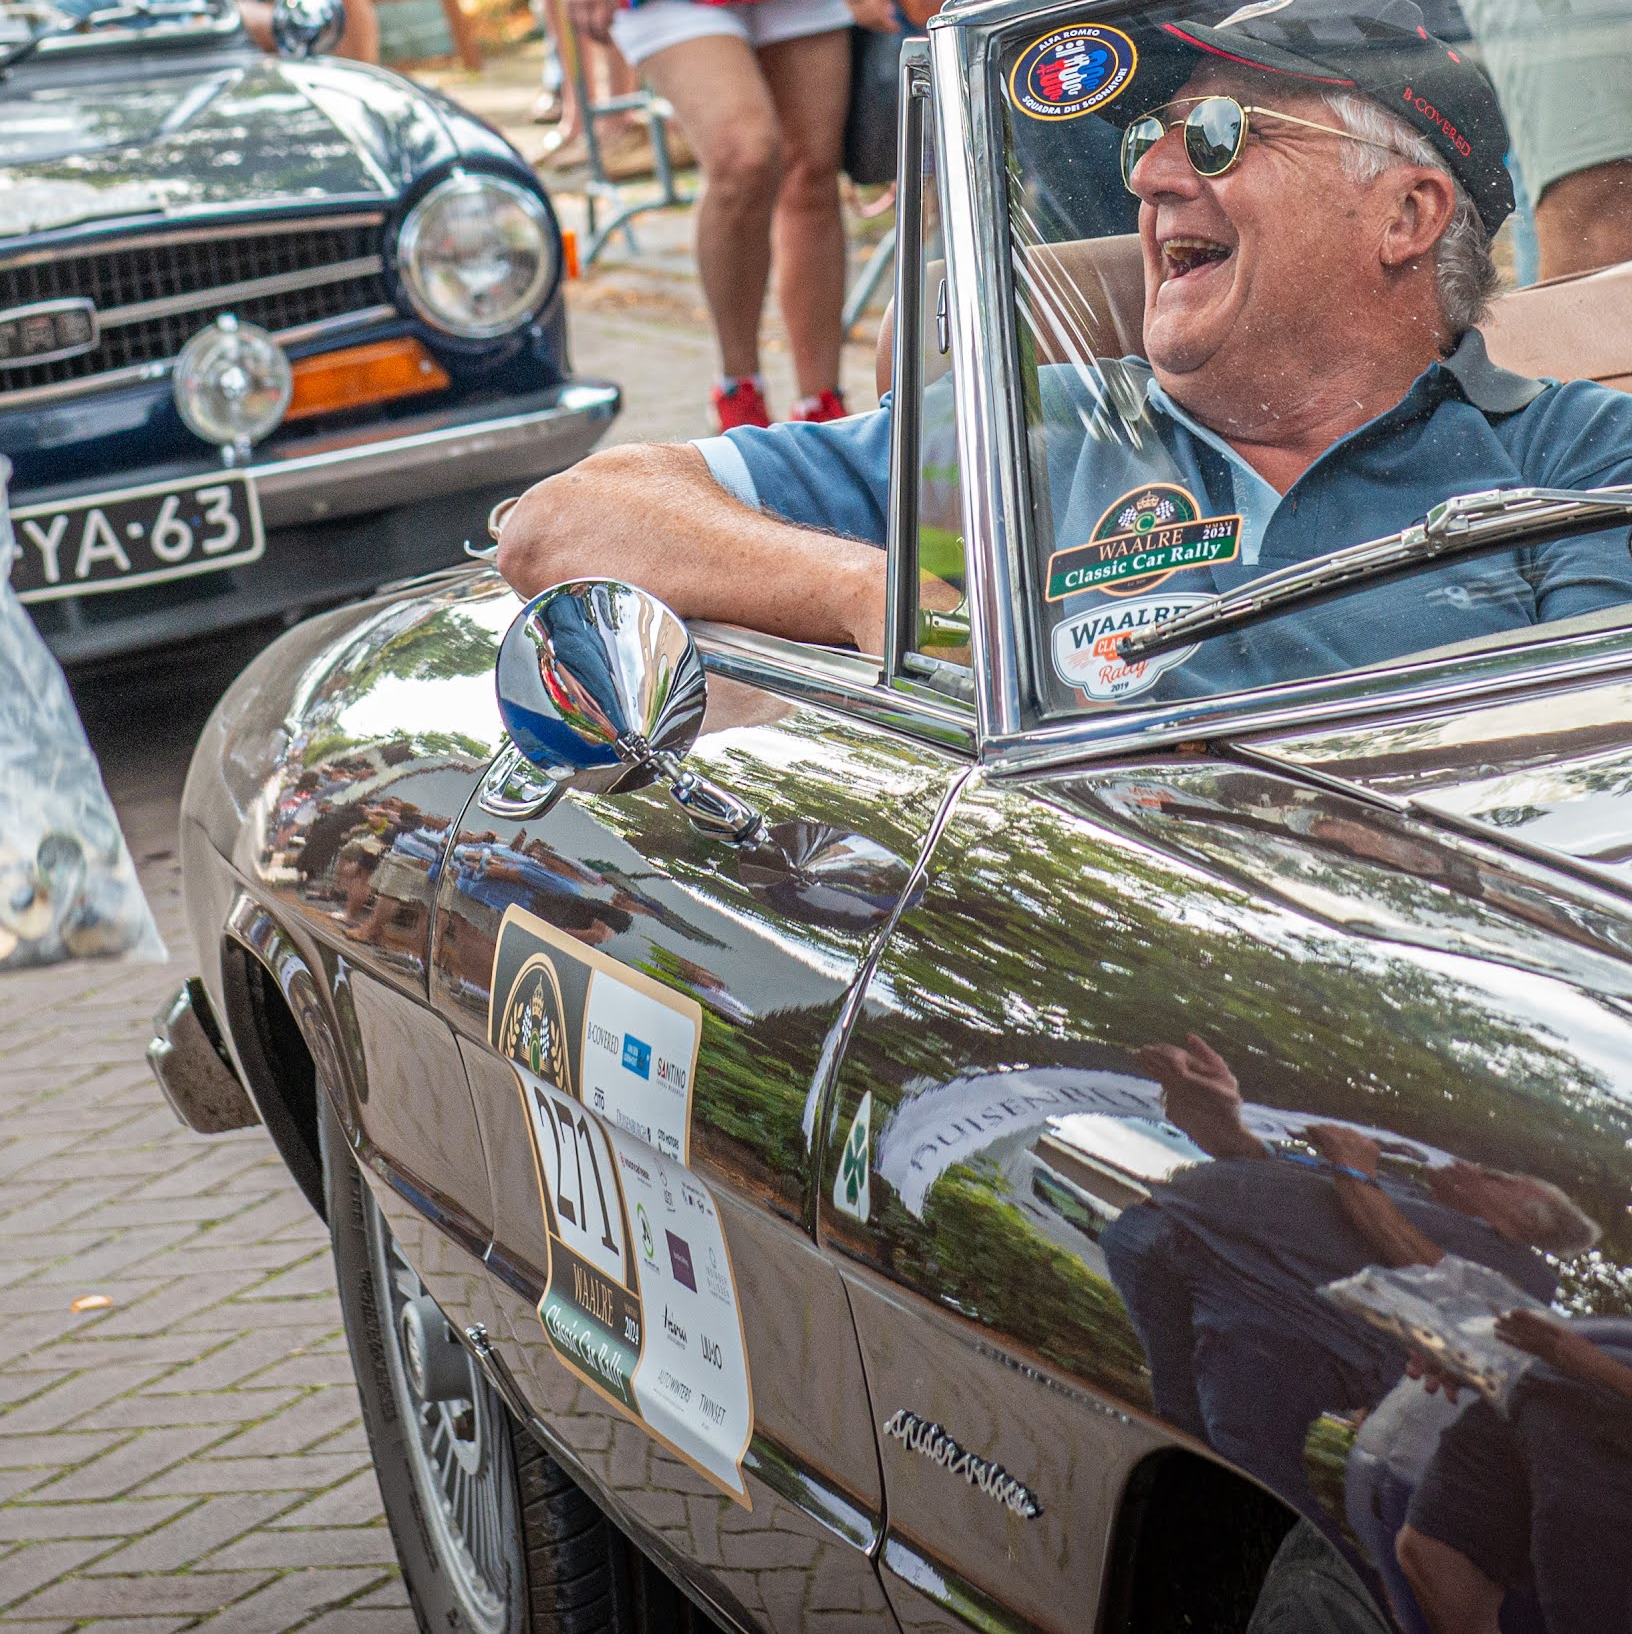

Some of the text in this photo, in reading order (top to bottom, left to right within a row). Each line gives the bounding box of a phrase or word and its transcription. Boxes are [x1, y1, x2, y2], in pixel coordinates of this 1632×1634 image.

[1038, 28, 1101, 52] ALFA ROMEO
[1021, 67, 1129, 115] SQUADRA DEI SOGNATORI
[1402, 86, 1472, 157] B-COVERED
[1098, 525, 1232, 562] WAALRE 2021
[1065, 558, 1128, 588] Classic
[1132, 554, 1166, 571] Car
[1169, 542, 1221, 564] Rally
[1110, 680, 1130, 693] 2019
[587, 1021, 620, 1056] B-COVERED
[656, 1057, 687, 1091] SANTINO
[534, 1086, 620, 1256] 271
[573, 1263, 614, 1328] WAALRE
[624, 1315, 640, 1346] 2024
[545, 1304, 581, 1358] Classic
[579, 1330, 599, 1371] Car
[597, 1342, 628, 1403] Rally
[699, 1392, 727, 1426] TWINSET
